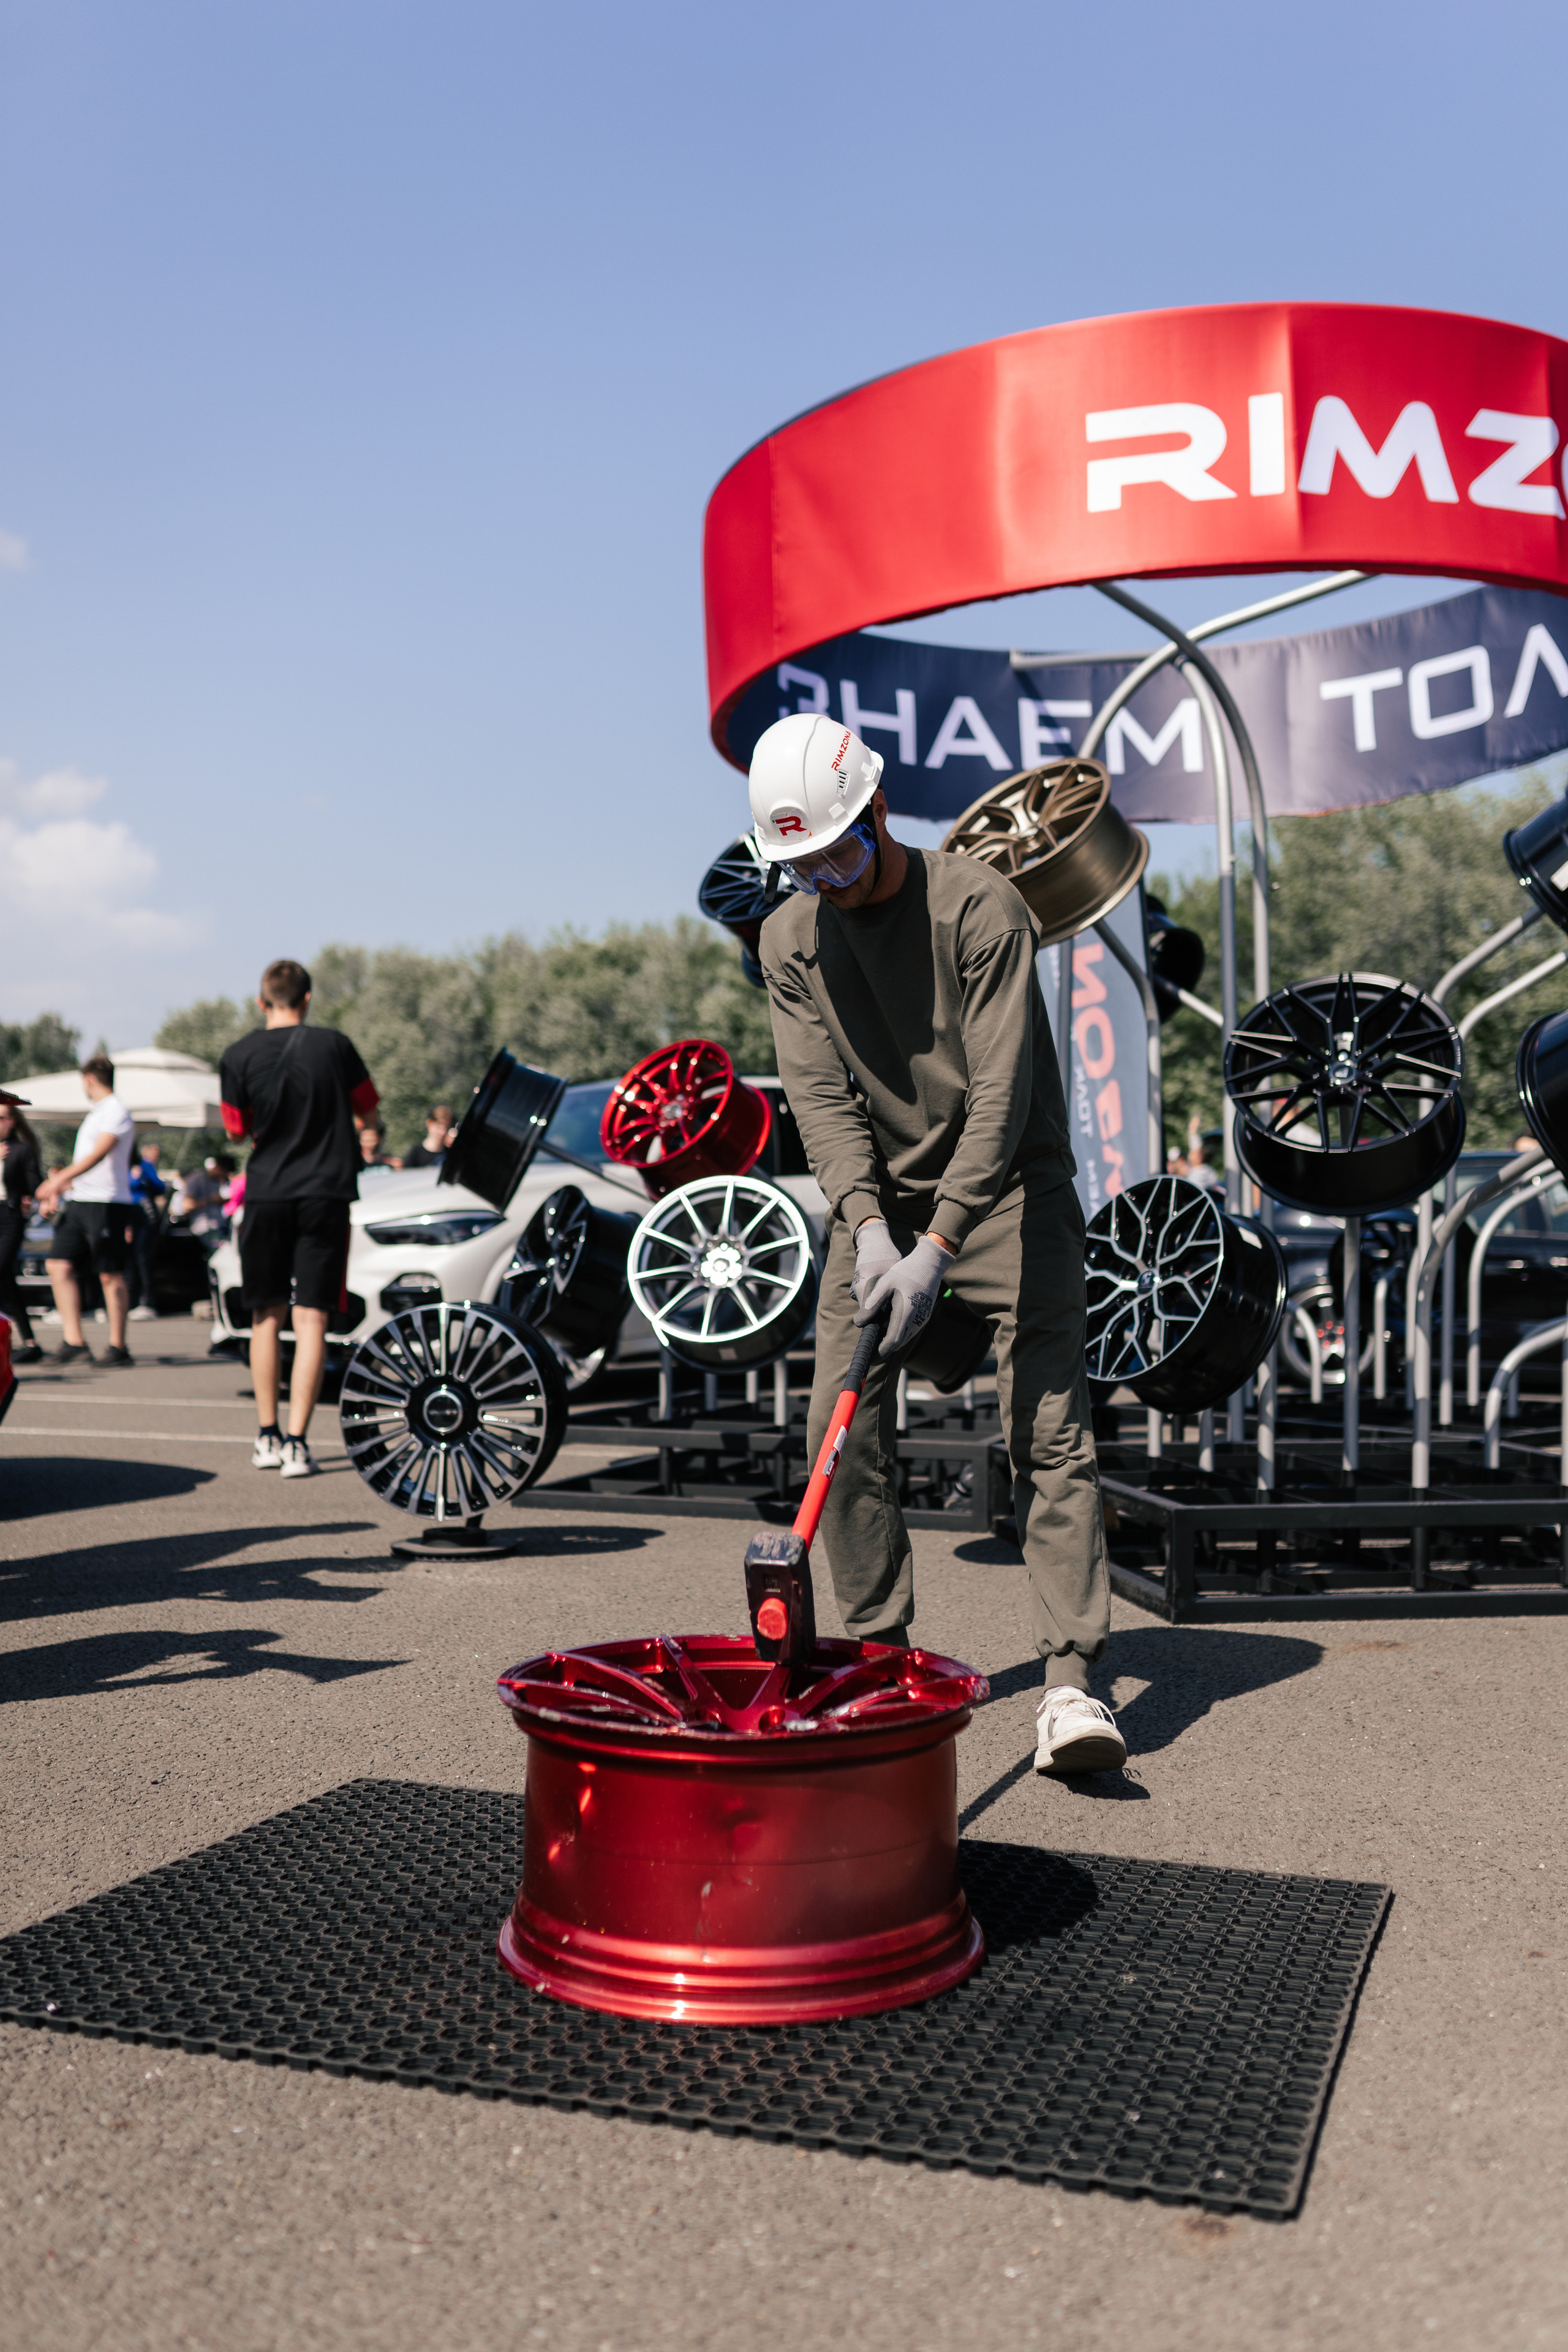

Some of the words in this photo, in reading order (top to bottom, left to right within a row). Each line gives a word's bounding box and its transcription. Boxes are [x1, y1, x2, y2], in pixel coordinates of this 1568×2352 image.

[1085, 391, 1568, 521] RIMZ
[831, 731, 851, 771] RIMZONA
[775, 815, 808, 837] R
